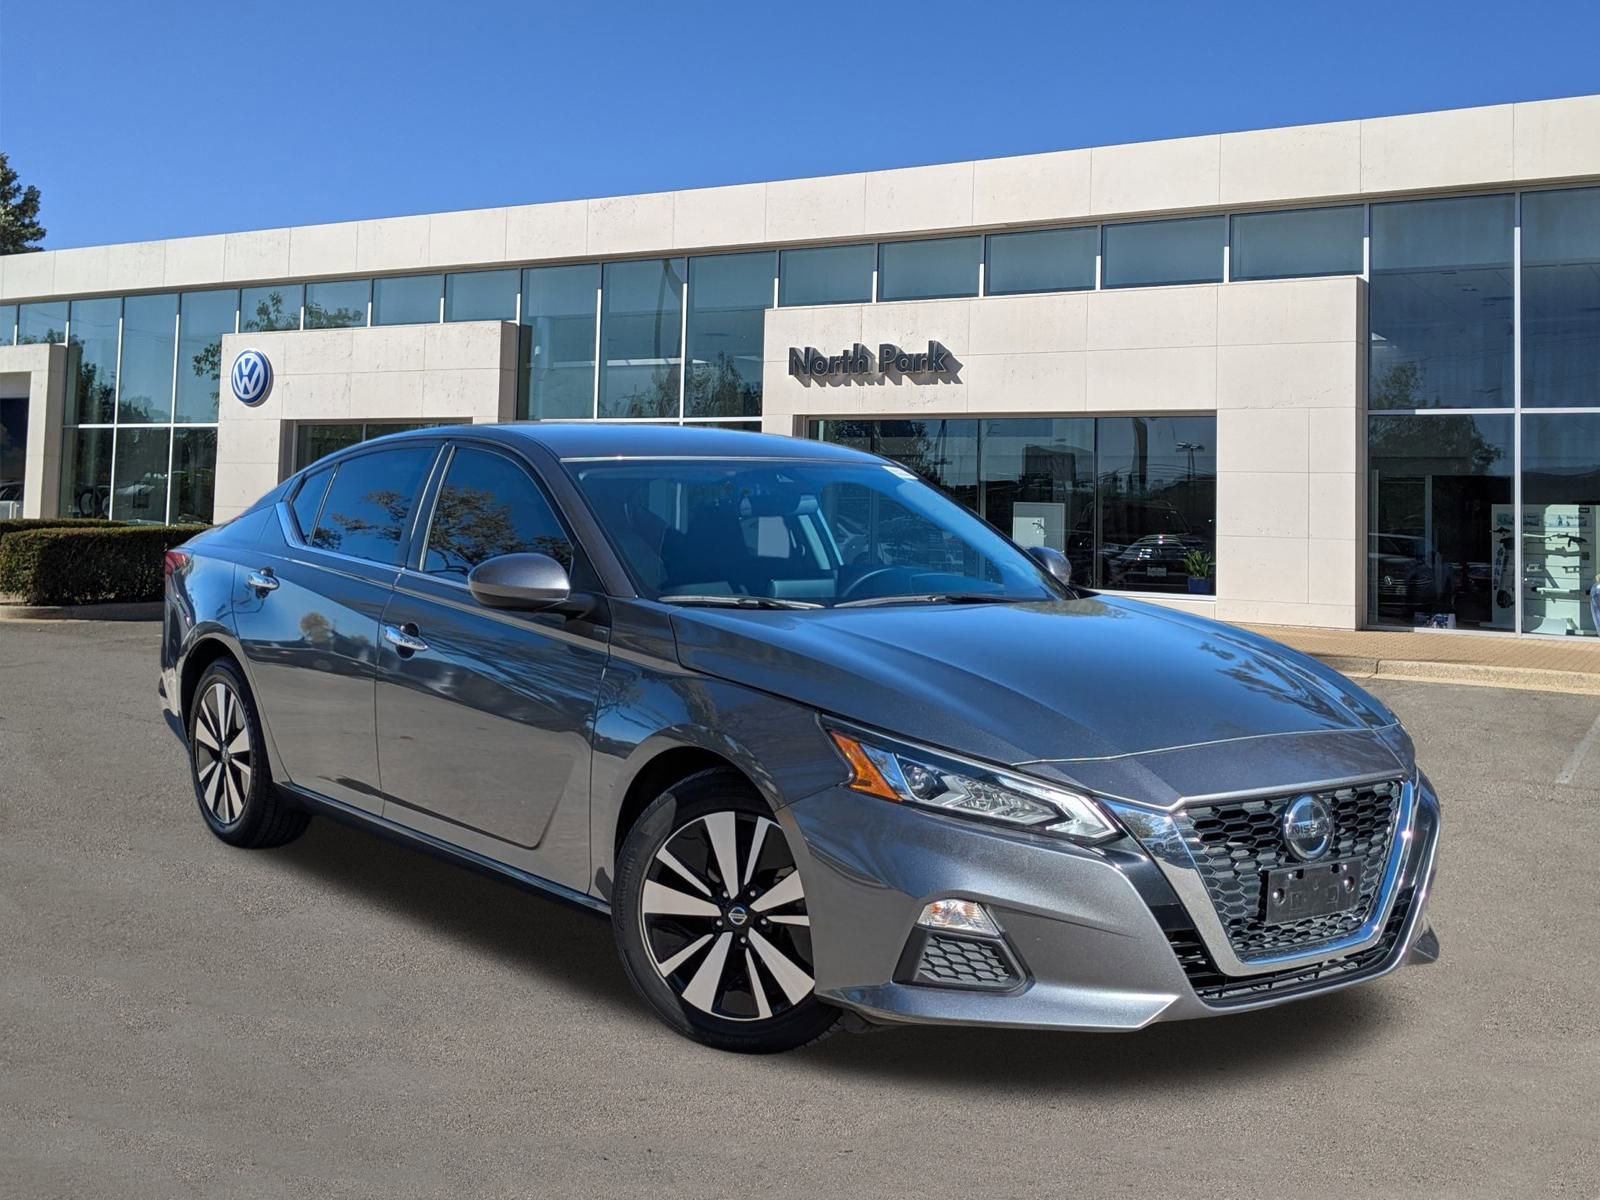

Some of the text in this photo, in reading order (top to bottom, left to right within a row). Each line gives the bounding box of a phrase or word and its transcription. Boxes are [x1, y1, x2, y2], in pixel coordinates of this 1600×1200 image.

[233, 352, 266, 401] VW
[788, 340, 949, 377] North Park
